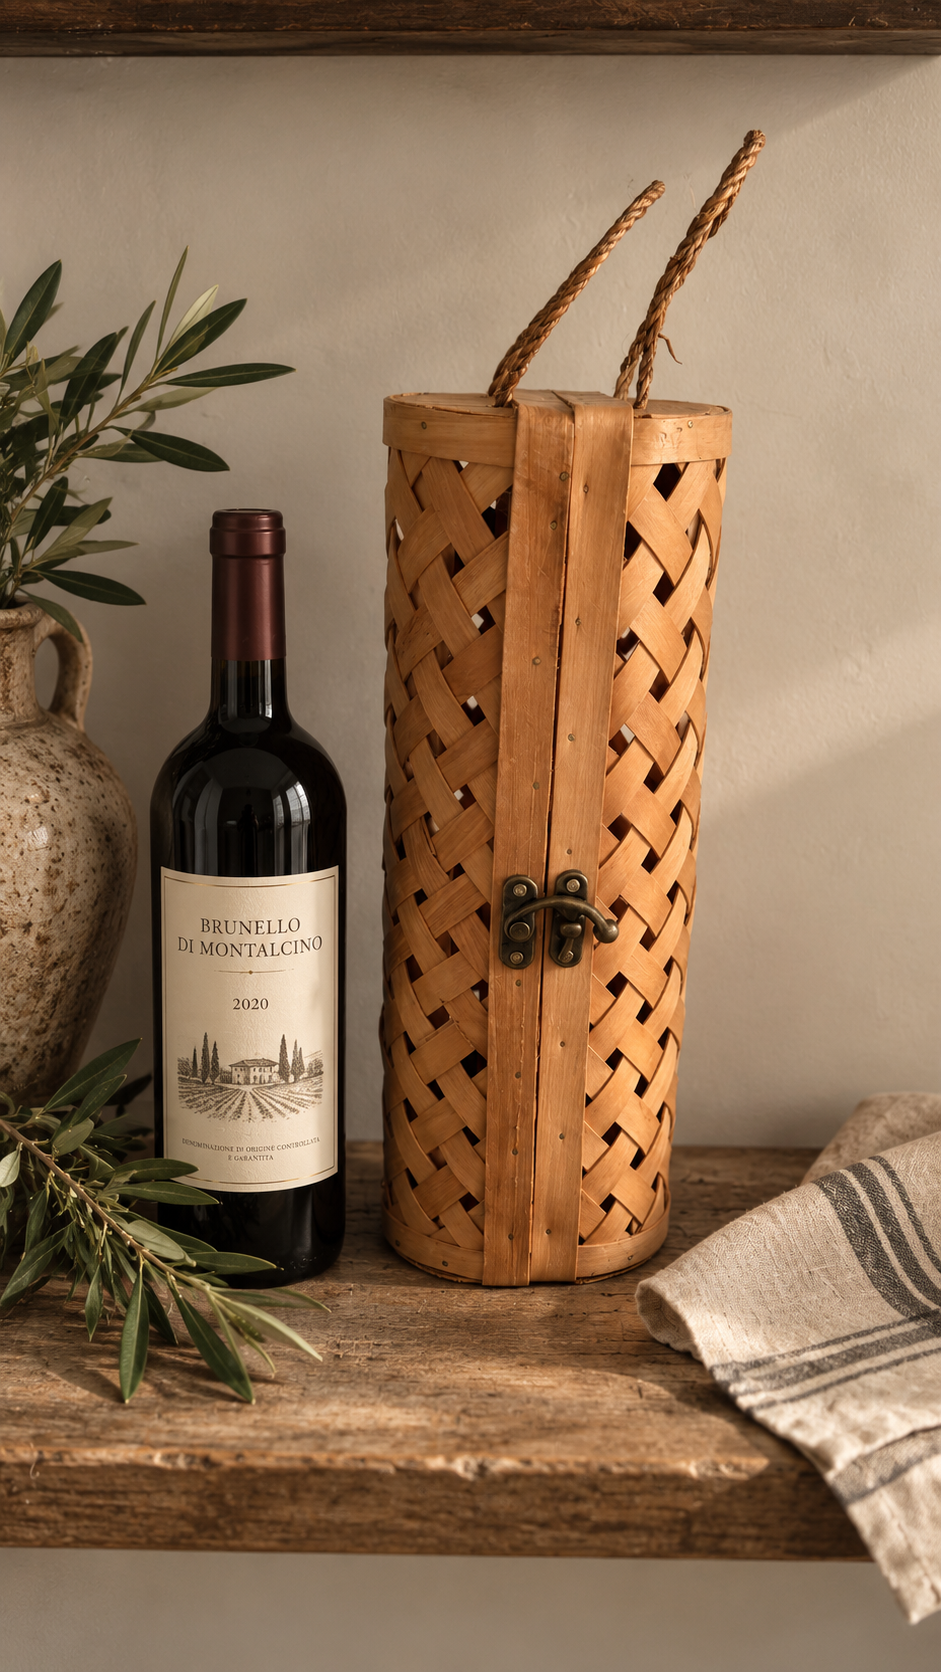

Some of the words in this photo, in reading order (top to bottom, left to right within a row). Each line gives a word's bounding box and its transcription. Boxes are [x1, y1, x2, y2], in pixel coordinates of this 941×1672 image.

[200, 917, 301, 935] BRUNELLO
[177, 936, 194, 954] DI
[199, 935, 323, 958] MONTALCINO
[232, 998, 269, 1010] 2020
